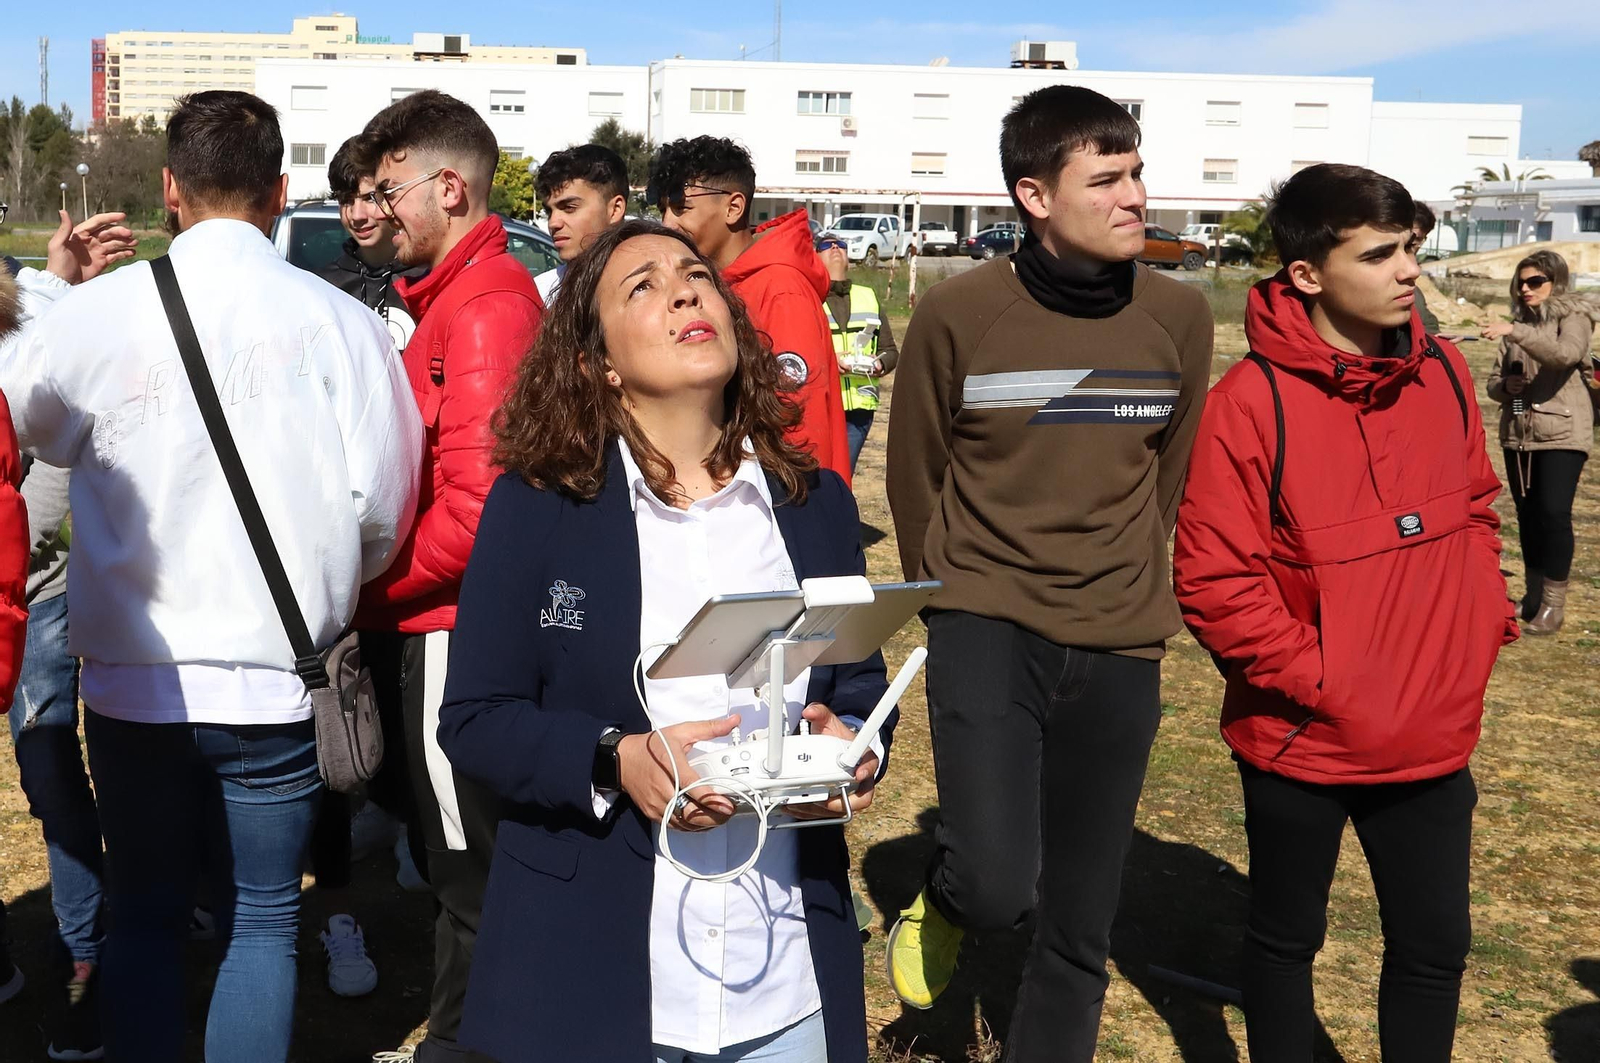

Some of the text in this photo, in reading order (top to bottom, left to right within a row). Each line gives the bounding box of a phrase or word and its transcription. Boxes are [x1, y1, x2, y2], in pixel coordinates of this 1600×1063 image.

[357, 35, 391, 43] Hospital
[1114, 404, 1172, 417] LOS ANGELES
